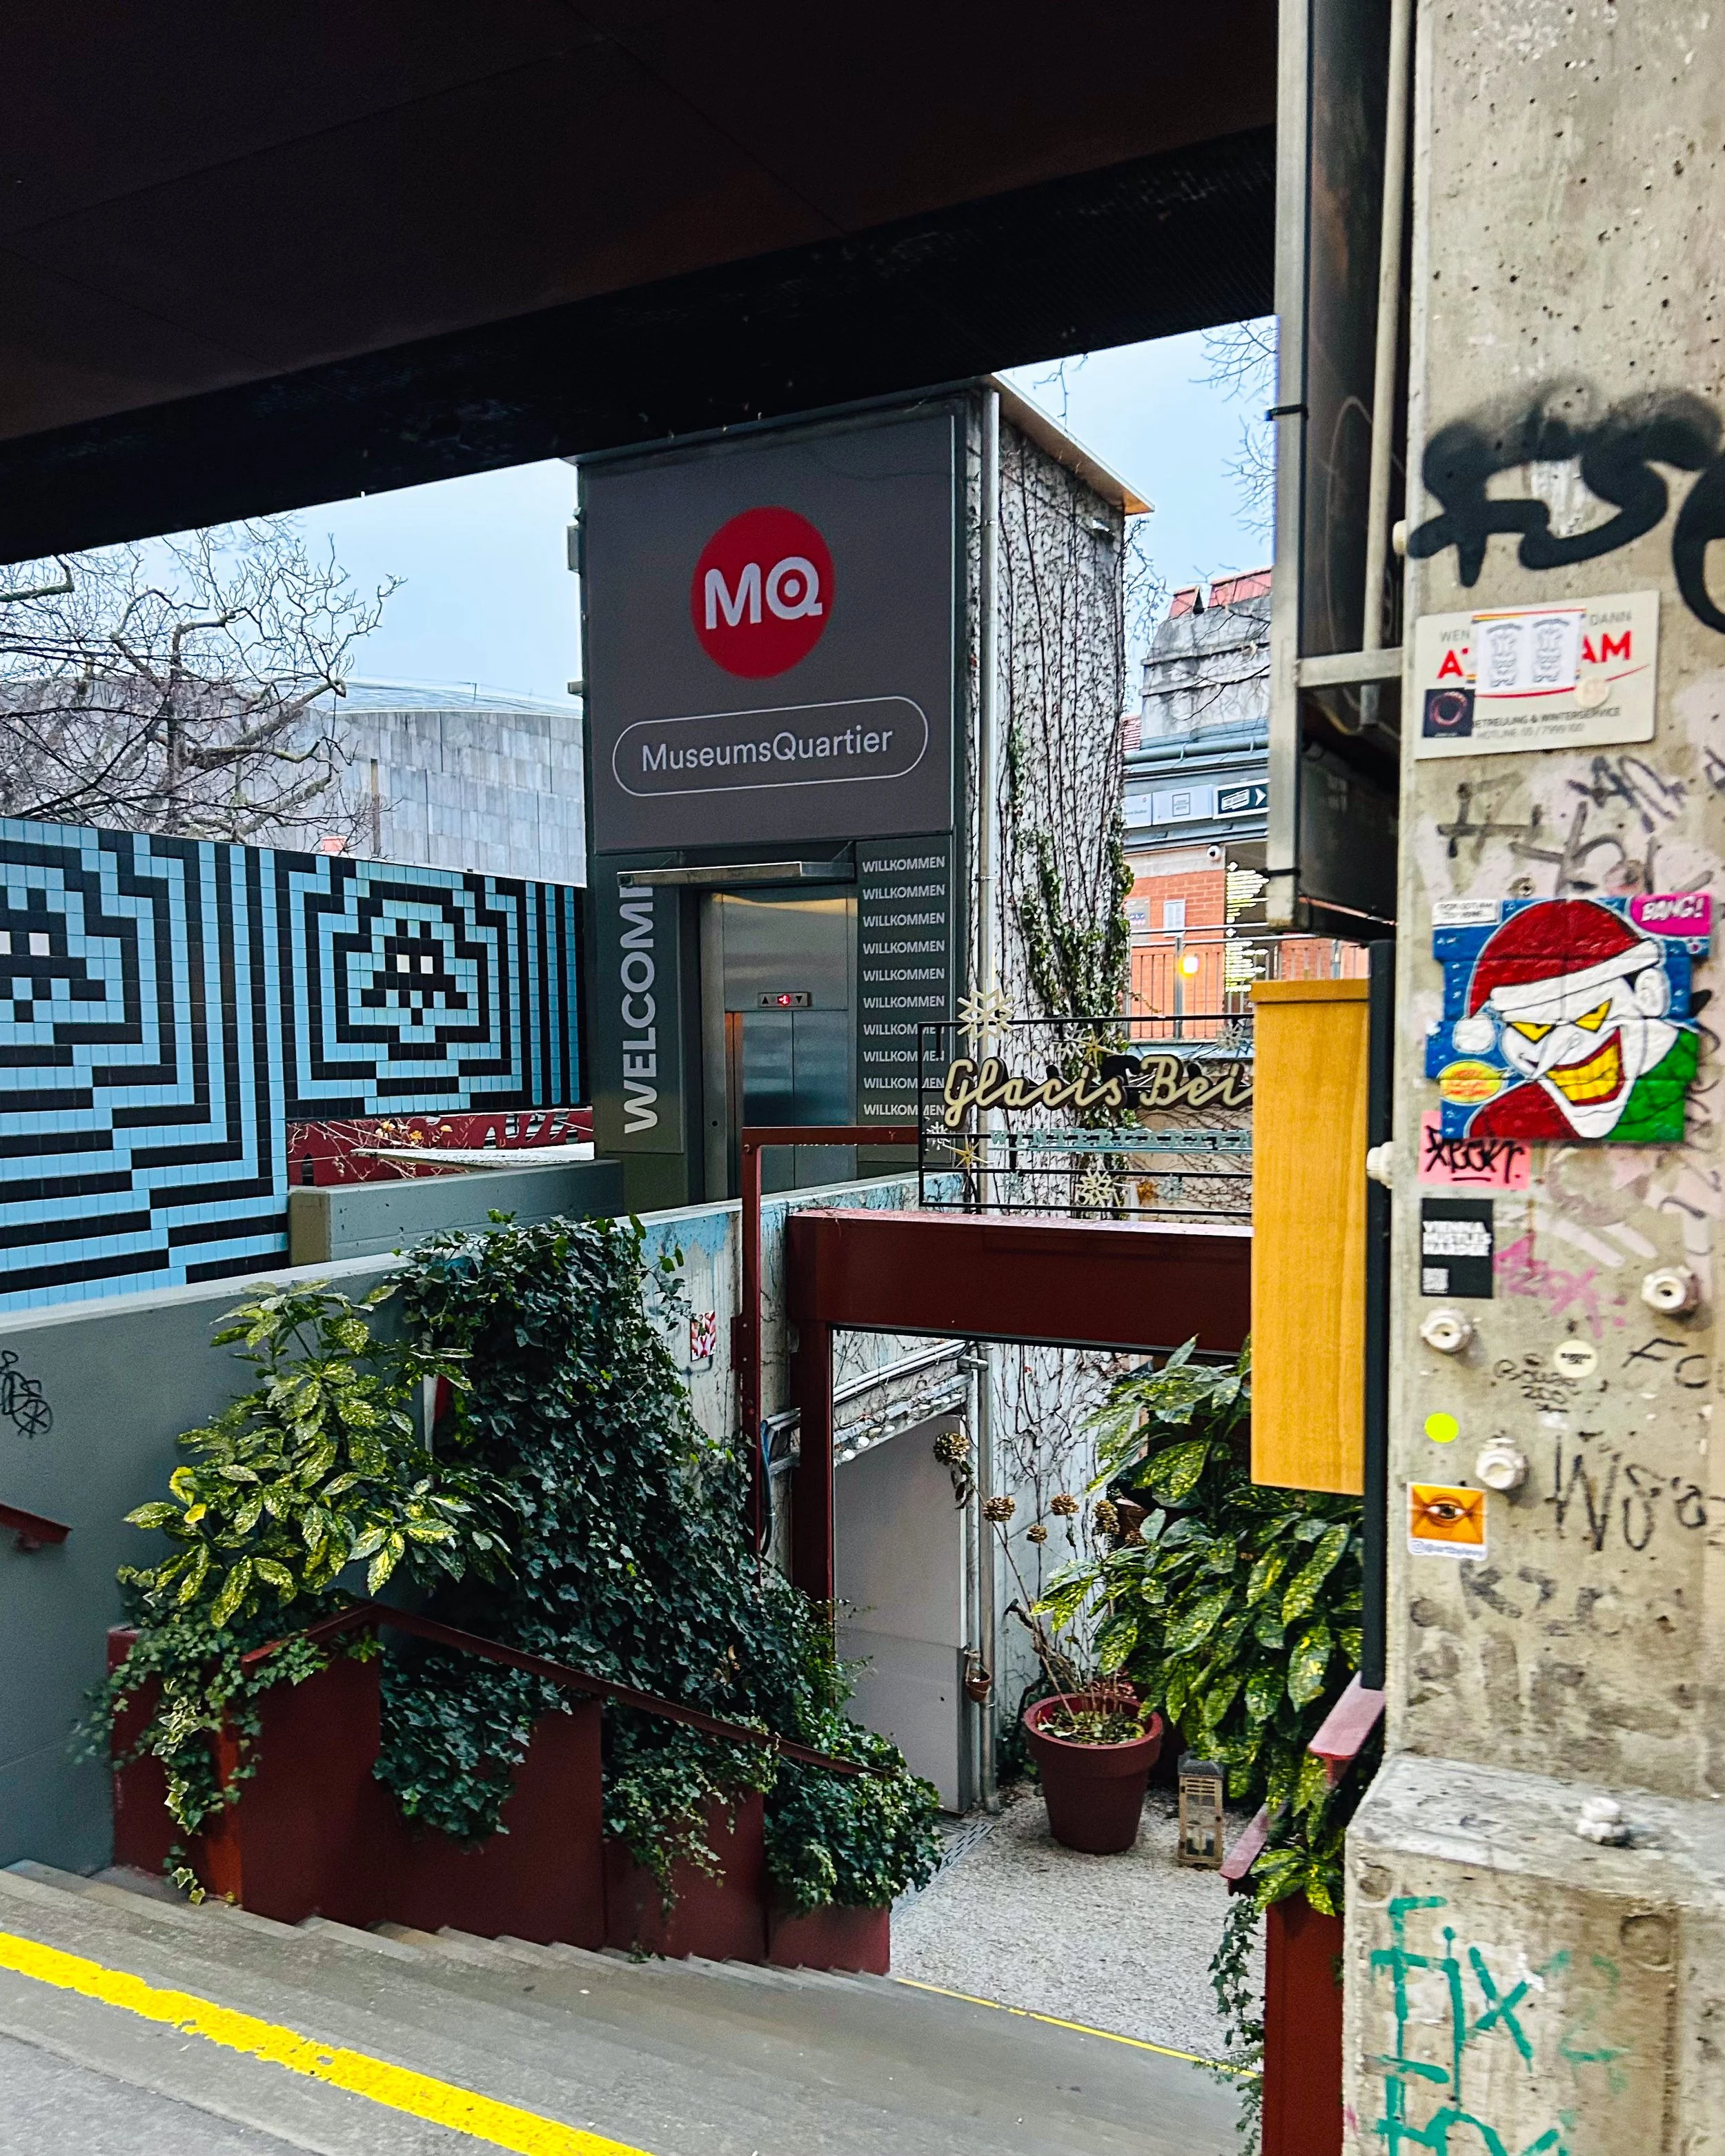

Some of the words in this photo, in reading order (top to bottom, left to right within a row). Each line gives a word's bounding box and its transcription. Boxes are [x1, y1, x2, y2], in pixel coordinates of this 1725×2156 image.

[704, 556, 823, 630] MQ
[642, 724, 894, 772] MuseumsQuartier
[862, 856, 945, 873] WILLKOMMEN
[862, 884, 945, 900] WILLKOMMEN
[862, 912, 945, 927] WILLKOMMEN
[862, 940, 945, 954] WILLKOMMEN
[862, 968, 945, 982] WILLKOMMEN
[862, 996, 945, 1009] WILLKOMMEN
[943, 1056, 1125, 1128] Glacis
